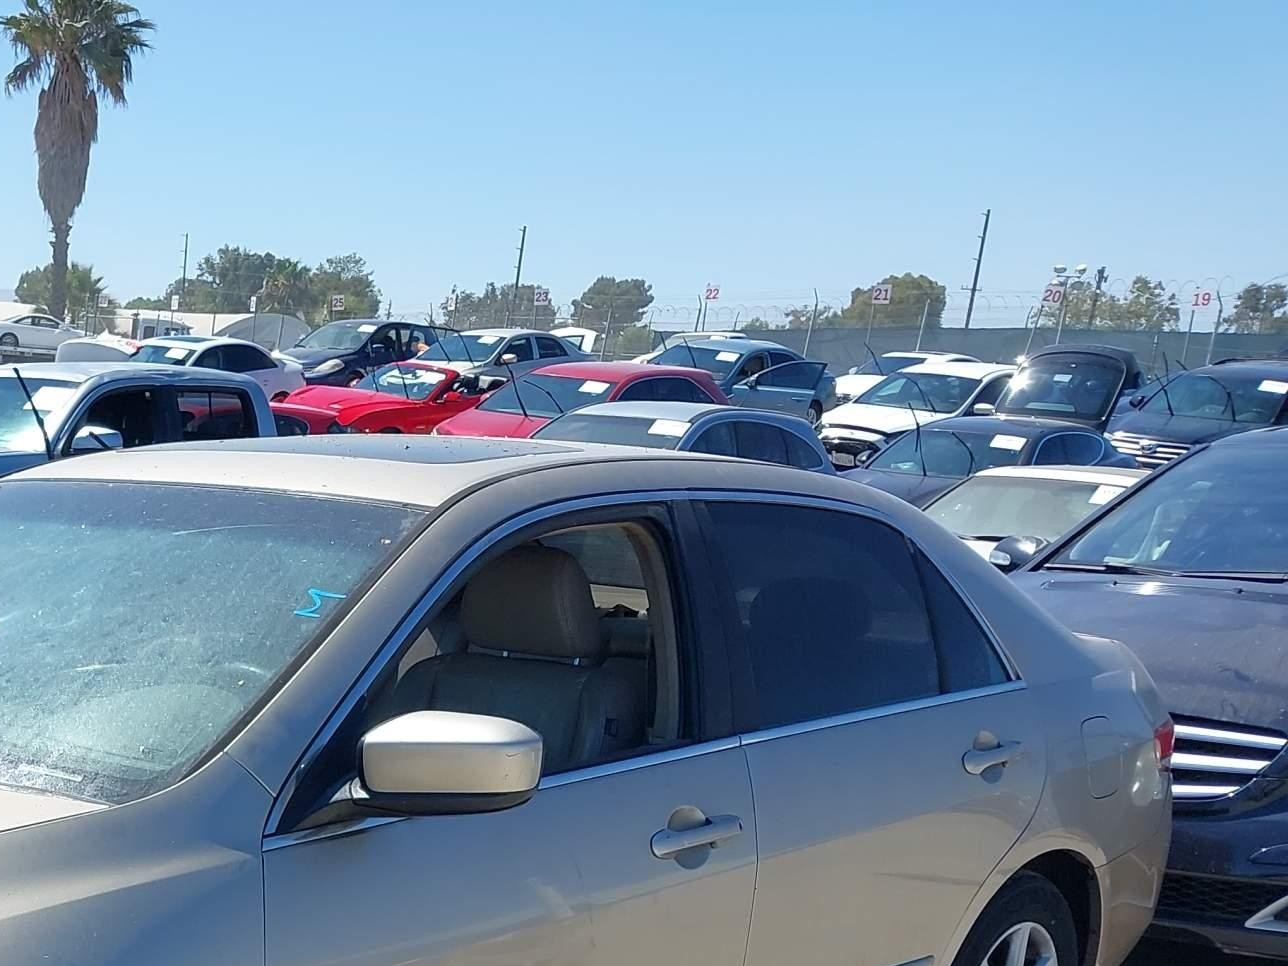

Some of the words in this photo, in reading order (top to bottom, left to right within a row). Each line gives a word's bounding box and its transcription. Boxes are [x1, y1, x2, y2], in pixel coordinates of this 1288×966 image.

[535, 291, 549, 303] 23
[705, 288, 720, 300] 22
[873, 287, 889, 301] 21
[1042, 289, 1062, 303] 20
[1192, 292, 1211, 306] 19
[333, 297, 344, 308] 25
